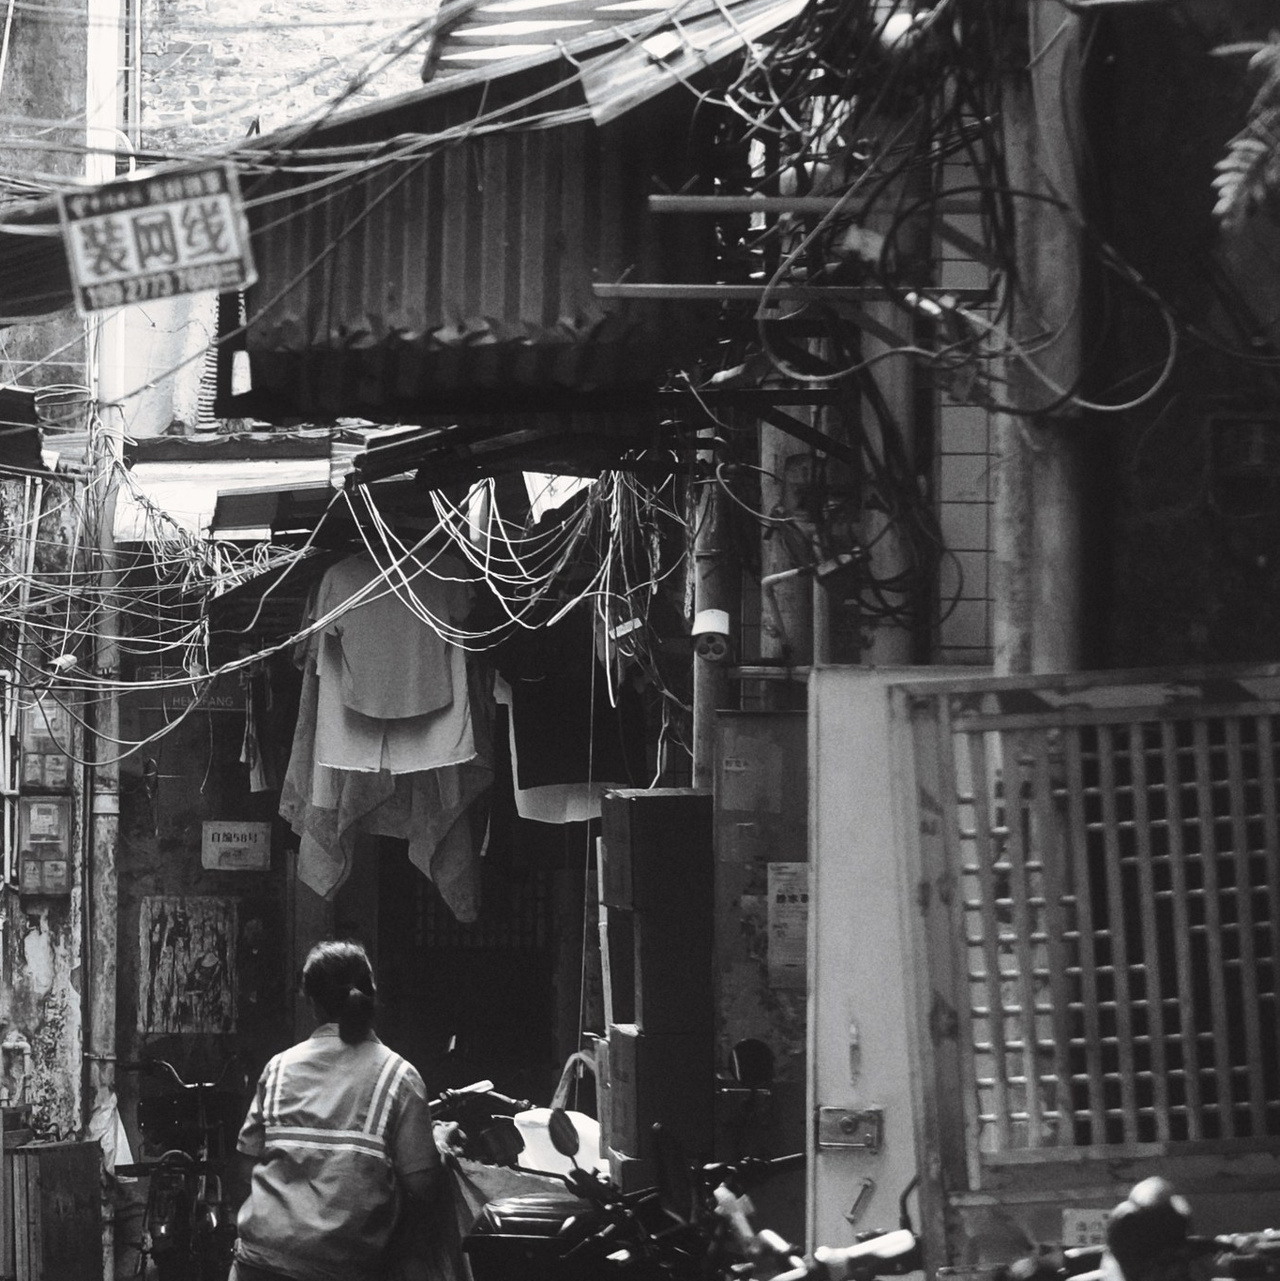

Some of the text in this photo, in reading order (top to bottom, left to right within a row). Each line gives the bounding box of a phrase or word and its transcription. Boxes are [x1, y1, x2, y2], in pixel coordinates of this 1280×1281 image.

[81, 201, 228, 276] 装网线
[172, 696, 234, 707] HEFANG
